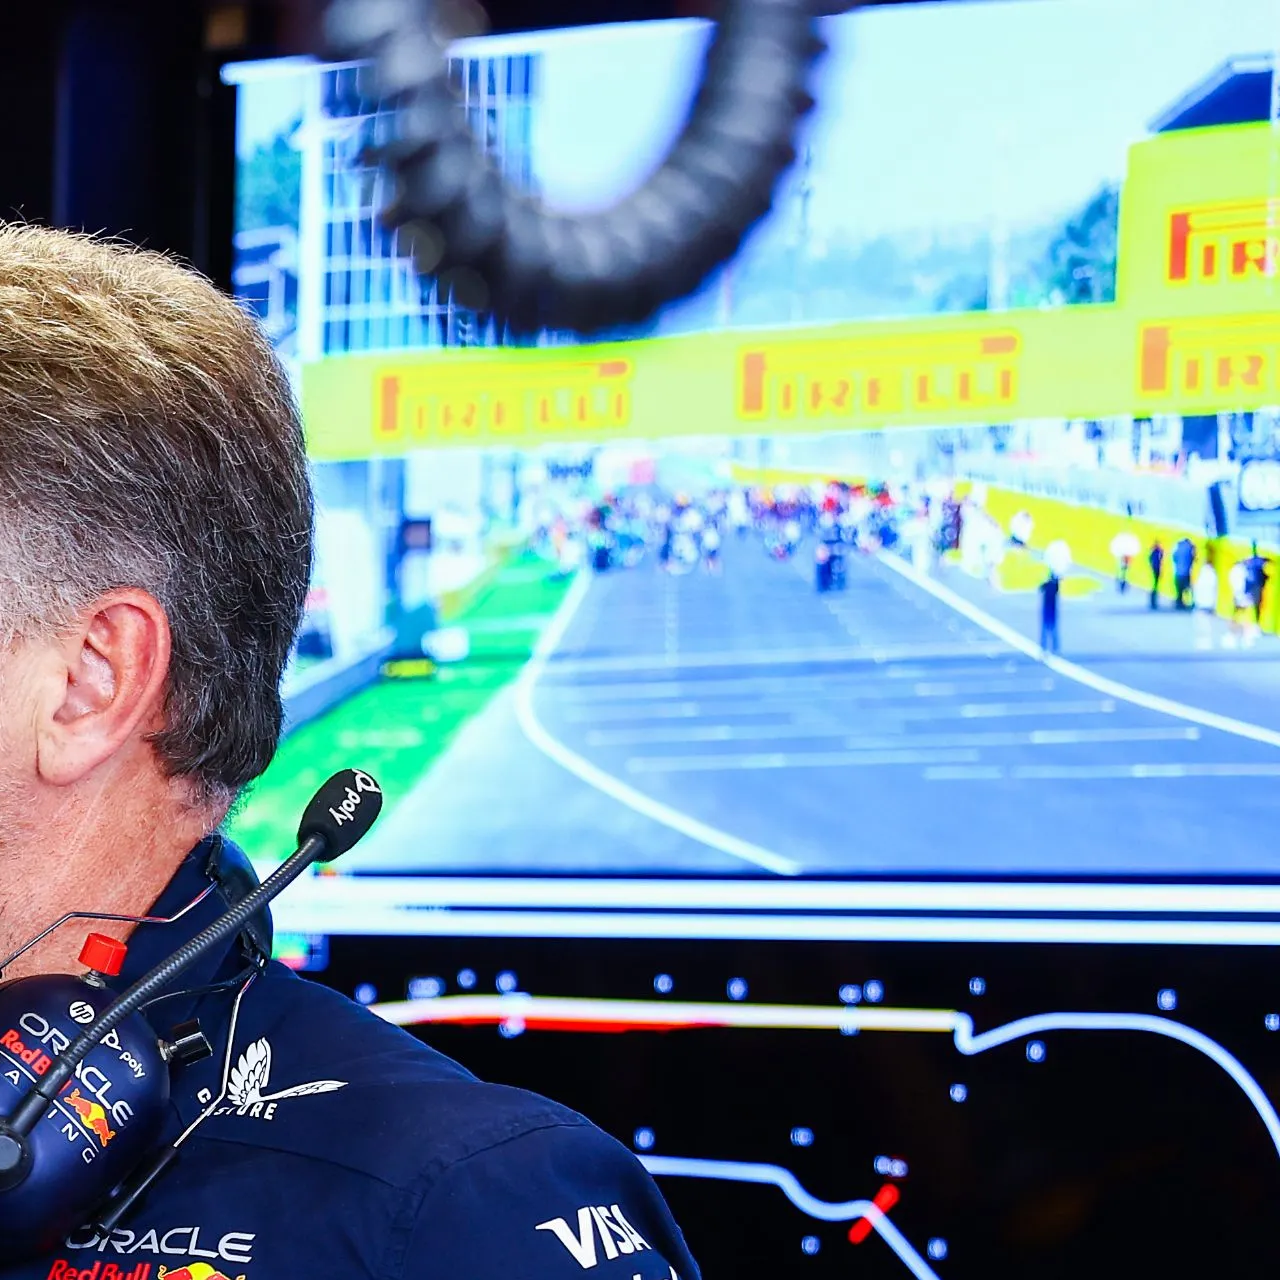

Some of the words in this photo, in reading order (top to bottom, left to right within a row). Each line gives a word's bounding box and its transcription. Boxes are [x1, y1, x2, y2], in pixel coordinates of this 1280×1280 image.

[380, 361, 629, 432] PIRELLI
[742, 335, 1019, 412] PIRELLI
[328, 786, 361, 826] poly
[69, 1001, 95, 1024] hp
[119, 1051, 145, 1078] poly
[535, 1204, 653, 1270] VISA
